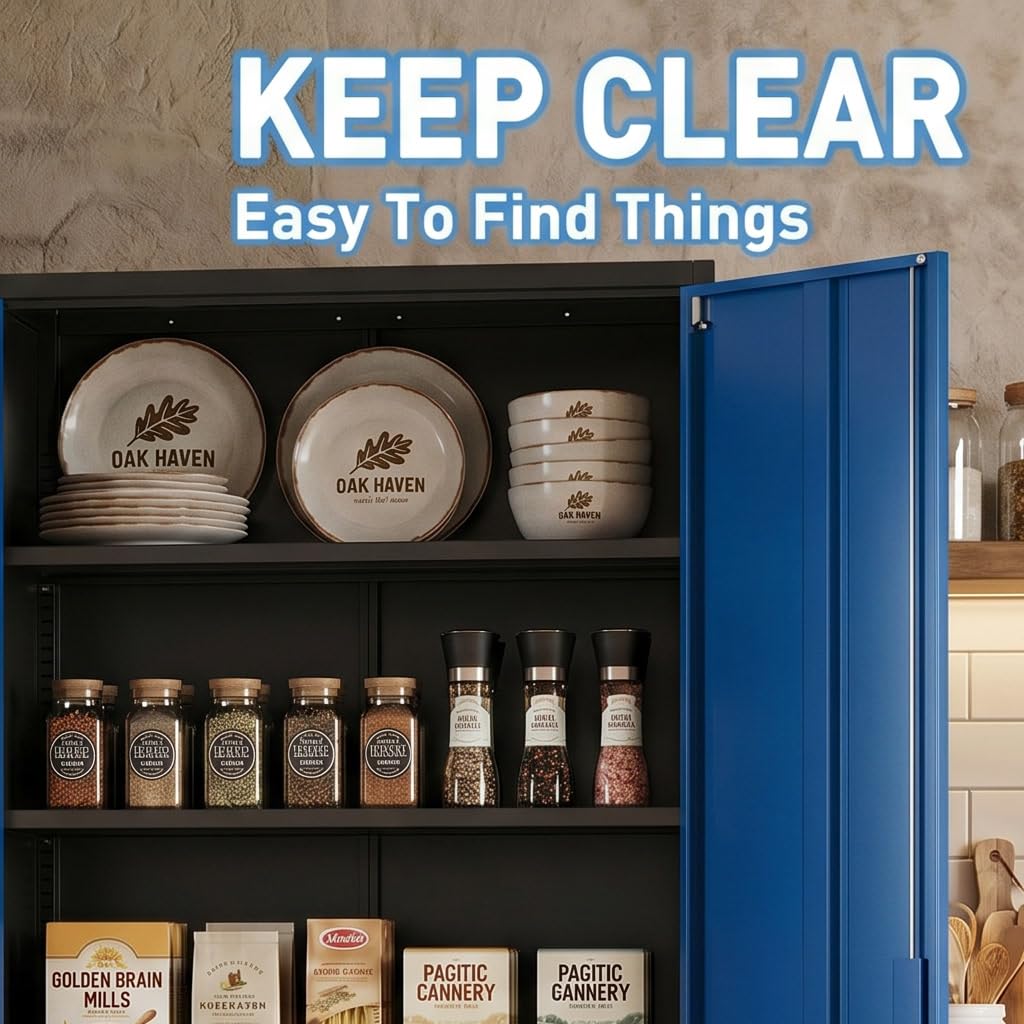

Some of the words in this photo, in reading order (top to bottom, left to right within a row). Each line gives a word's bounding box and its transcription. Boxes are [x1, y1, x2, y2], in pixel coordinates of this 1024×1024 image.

[111, 449, 149, 469] OAK
[155, 449, 215, 468] HAVEN
[336, 477, 369, 494] OAK
[374, 477, 425, 493] HAVEN
[52, 971, 111, 989] GOLDEN
[116, 971, 163, 989] BRAIN
[423, 963, 488, 982] PAGITIC
[558, 963, 623, 982] PAGITIC
[84, 991, 131, 1009] MILLS
[417, 983, 496, 1002] CANNERY
